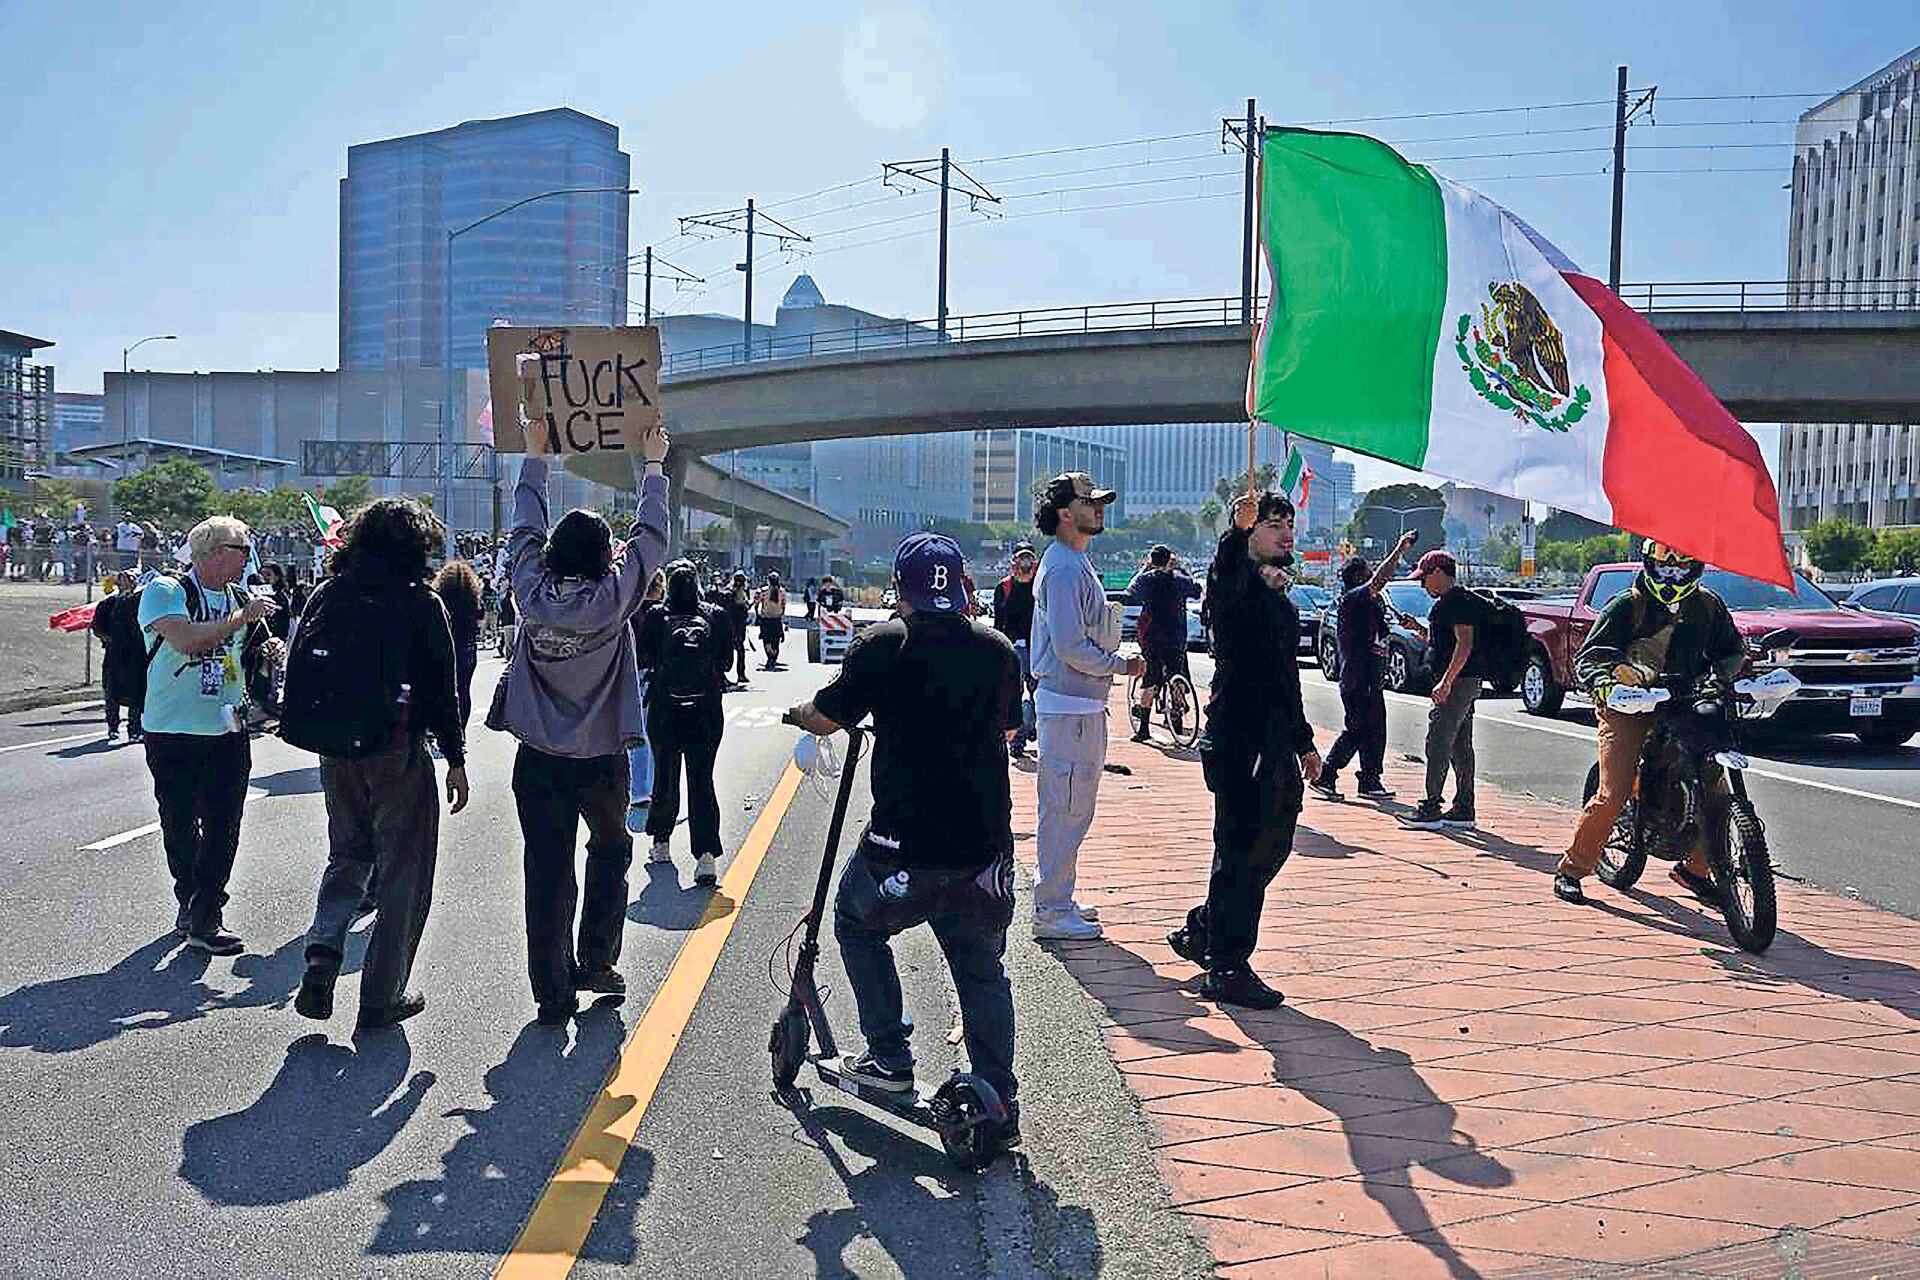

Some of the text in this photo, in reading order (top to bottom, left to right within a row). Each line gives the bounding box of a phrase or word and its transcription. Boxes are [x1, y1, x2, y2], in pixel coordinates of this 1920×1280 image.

[539, 352, 651, 409] FUCK
[545, 409, 625, 454] ICE
[930, 563, 948, 591] B
